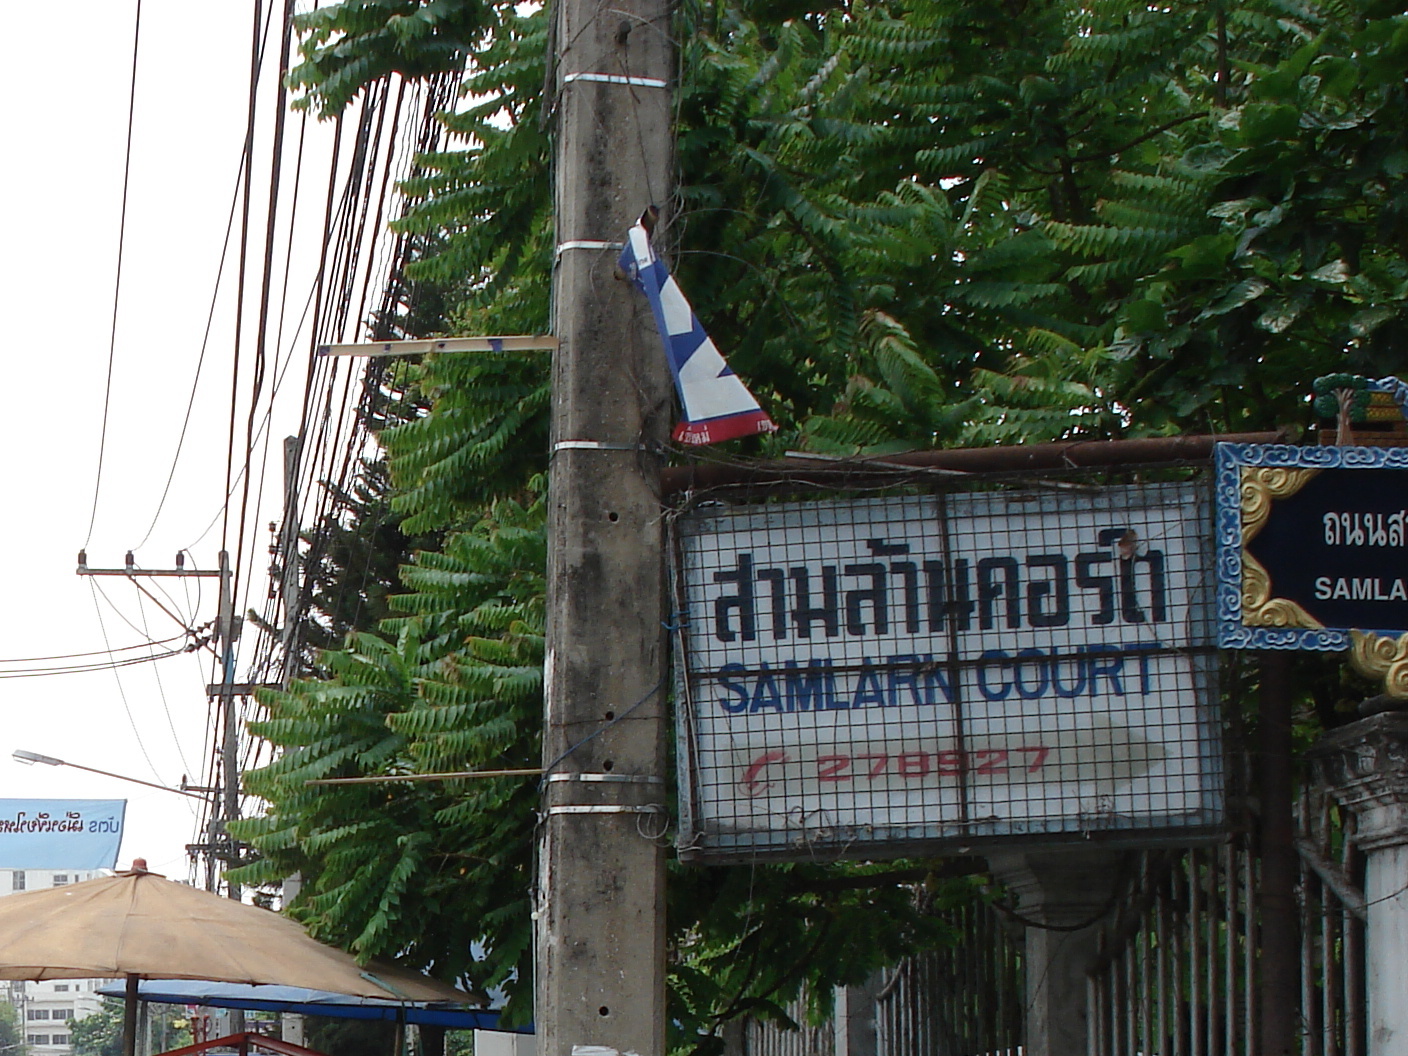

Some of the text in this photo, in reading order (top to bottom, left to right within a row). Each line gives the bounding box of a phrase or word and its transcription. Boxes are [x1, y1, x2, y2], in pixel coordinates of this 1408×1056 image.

[1323, 510, 1408, 546] ถนนส
[1314, 577, 1408, 600] SAMLA
[718, 642, 1164, 714] SAMLARN COURT
[817, 745, 1049, 782] 278927
